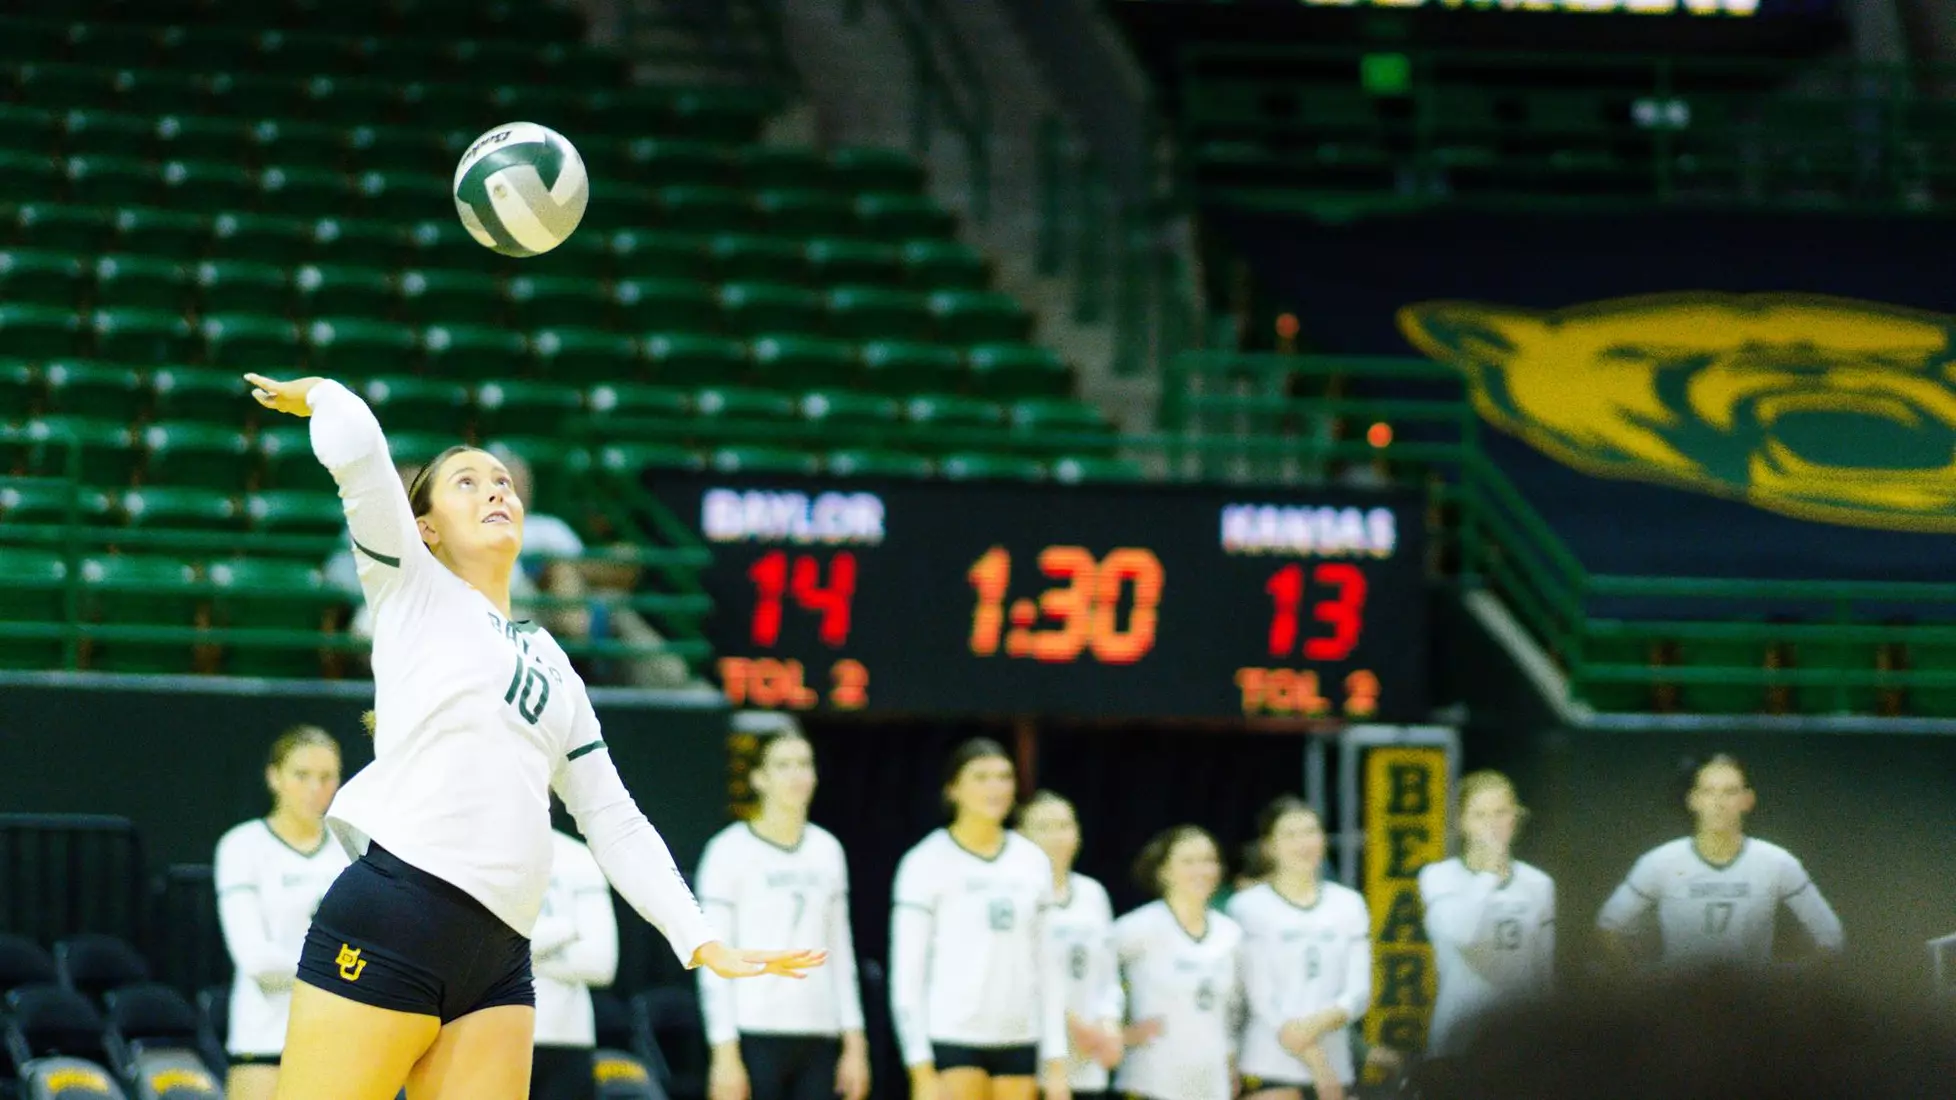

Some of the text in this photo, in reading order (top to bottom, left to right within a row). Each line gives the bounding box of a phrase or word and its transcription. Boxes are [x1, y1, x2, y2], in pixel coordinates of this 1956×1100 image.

[702, 488, 886, 542] BAYLOR
[1221, 505, 1396, 557] KANSAS
[748, 550, 857, 648] 14
[967, 545, 1166, 665] 1:30
[1265, 562, 1368, 661] 13
[503, 653, 550, 726] 10
[718, 656, 819, 709] TOL
[1234, 666, 1331, 717] TOL
